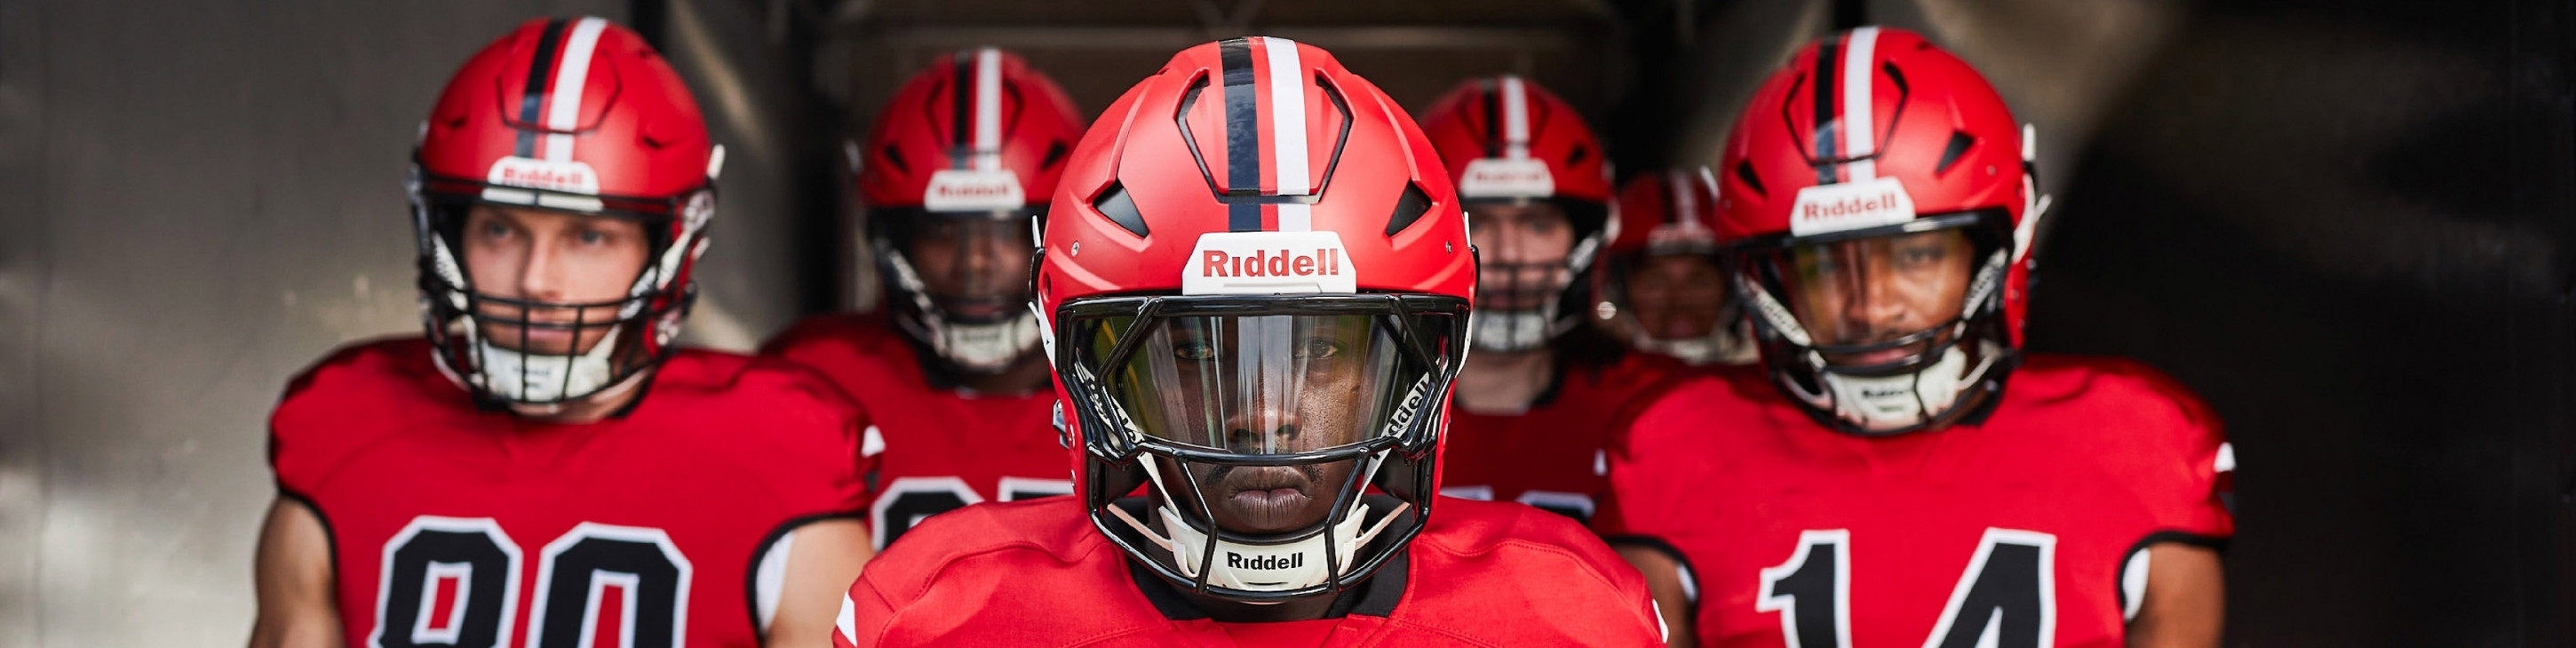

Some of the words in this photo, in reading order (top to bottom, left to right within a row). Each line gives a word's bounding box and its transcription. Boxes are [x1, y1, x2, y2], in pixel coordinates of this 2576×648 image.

[1802, 193, 1896, 220] Riddell
[1203, 249, 1339, 277] Riddell
[1387, 380, 1429, 436] ddell
[367, 515, 693, 648] 80
[1227, 551, 1303, 571] Riddell
[1755, 526, 2057, 648] 14
